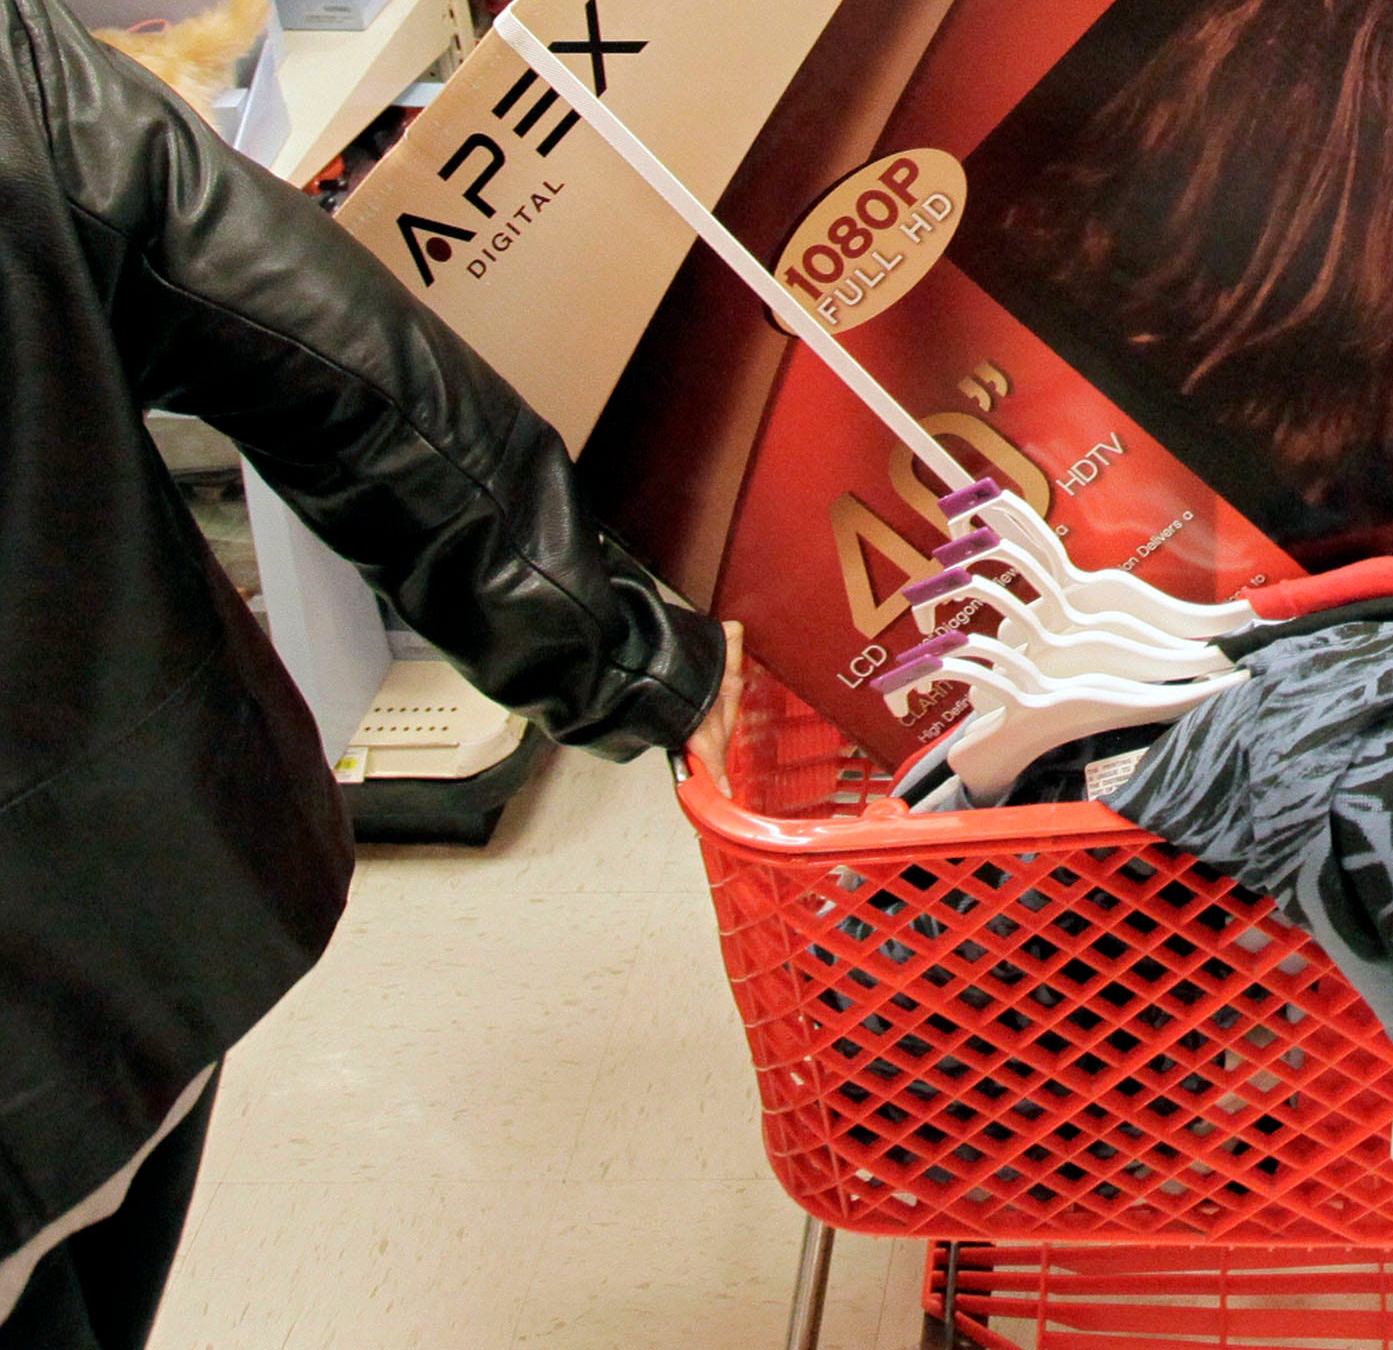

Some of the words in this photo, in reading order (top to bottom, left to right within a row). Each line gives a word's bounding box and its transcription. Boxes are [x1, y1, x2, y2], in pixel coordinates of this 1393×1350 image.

[466, 179, 566, 281] DIGITAL
[783, 156, 920, 302] 1080P
[816, 250, 905, 326] FULL
[899, 192, 953, 245] HD
[1055, 431, 1127, 497] HDTV
[1135, 518, 1184, 559] Delivers
[836, 644, 888, 689] LCD
[917, 717, 945, 743] High
